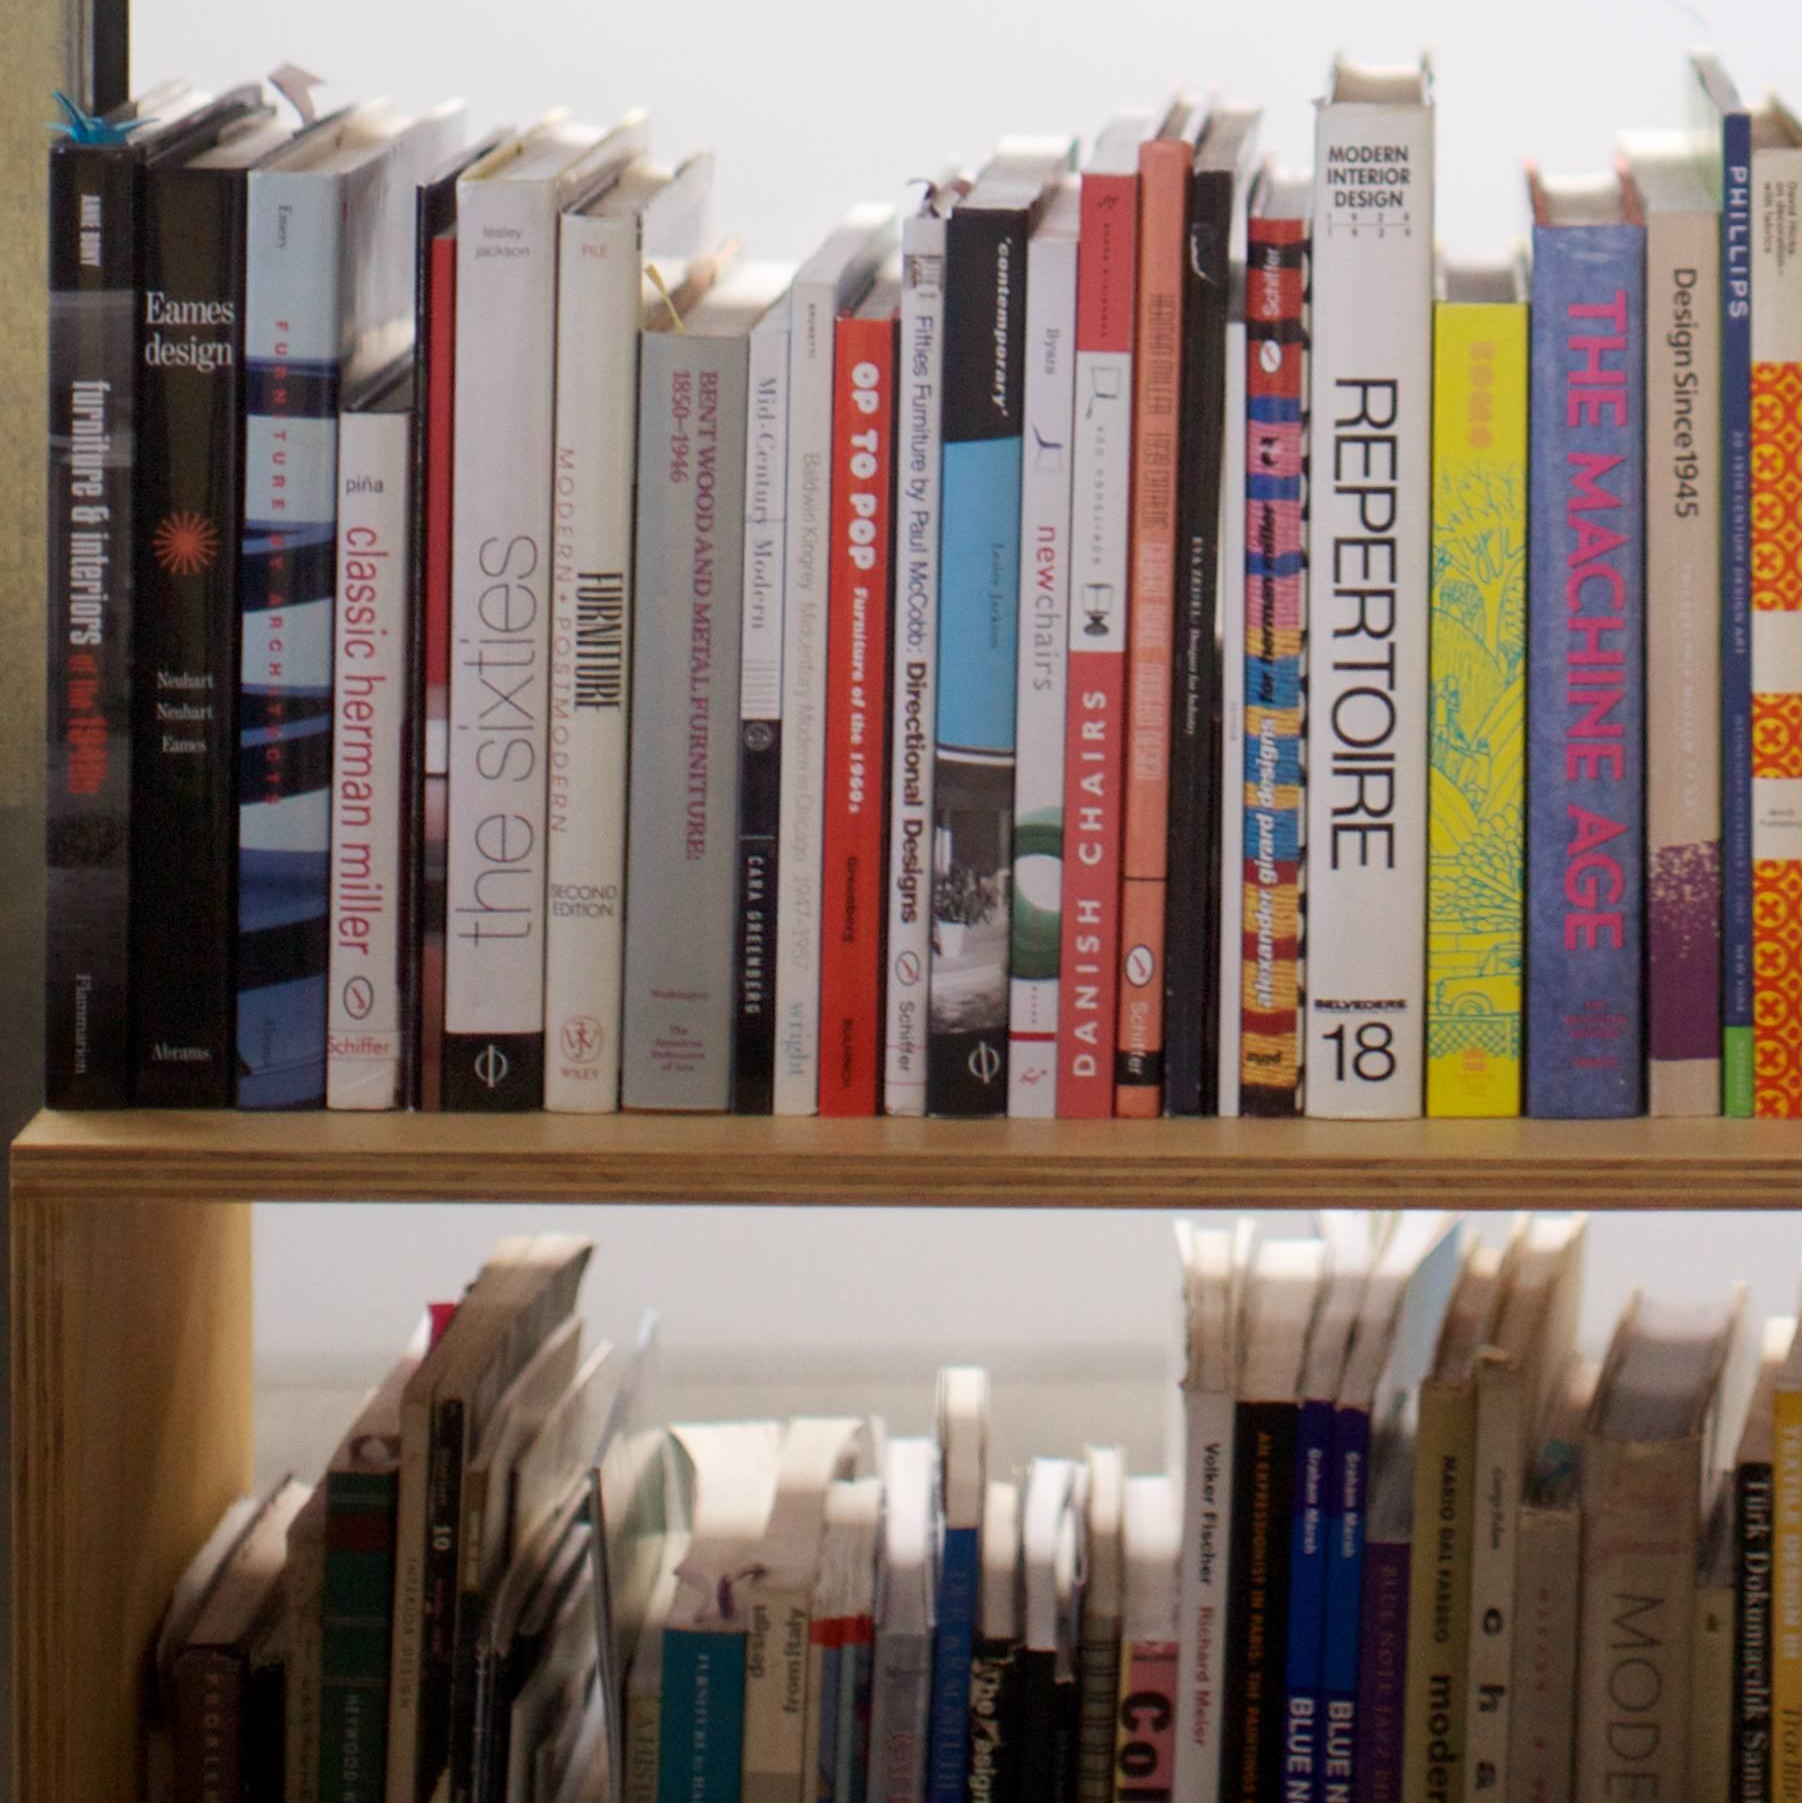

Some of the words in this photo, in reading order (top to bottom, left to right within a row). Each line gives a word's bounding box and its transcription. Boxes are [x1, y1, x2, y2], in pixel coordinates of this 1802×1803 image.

[1326, 168, 1411, 185] INTERIOR
[1328, 146, 1409, 162] MODERN
[275, 205, 292, 250] Emery
[1335, 190, 1404, 208] DESIGN
[1728, 165, 1748, 320] PHILLIPS
[144, 291, 236, 325] Eames
[1261, 246, 1282, 319] Schiffer
[1667, 267, 1698, 367] Design
[144, 333, 233, 374] design
[912, 315, 933, 377] Fifties
[1567, 289, 1627, 427] THE
[698, 371, 718, 440] BENT
[851, 360, 880, 414] OP
[71, 380, 110, 496] furniture
[750, 377, 777, 526] Mid-Century
[849, 429, 879, 479] TO
[910, 383, 933, 472] Furniture
[71, 505, 110, 525] &
[345, 478, 384, 494] piña
[556, 447, 576, 582] MODERN
[694, 446, 716, 533] WOOD
[906, 477, 931, 502] by
[691, 539, 714, 598] AND
[848, 493, 878, 570] POP
[909, 510, 929, 553] Paul
[70, 532, 110, 646] interiors
[344, 527, 388, 660] classic
[750, 538, 776, 630] Modern
[905, 561, 928, 653] McCobb:
[1565, 451, 1628, 781] MACHINE
[456, 534, 539, 783] sixties
[573, 571, 624, 713] FURNITURE
[690, 601, 711, 691] METAL
[851, 587, 868, 682] Furniture
[1331, 377, 1398, 871] REPERTOIRE
[67, 654, 98, 676] of
[68, 679, 98, 710] the
[850, 687, 867, 709] of
[342, 674, 386, 828] herman
[550, 616, 570, 834] POSTMODERN
[850, 713, 866, 745] the
[903, 661, 926, 806] Directional
[1255, 717, 1274, 808] designs
[686, 696, 709, 861] FURNITURE:
[847, 752, 864, 814] 1960s
[1079, 690, 1108, 865] CHAIRS
[455, 813, 533, 949] the
[746, 855, 765, 904] CARA
[898, 819, 924, 924] Designs
[1255, 813, 1274, 884] girard
[1563, 803, 1629, 951] AGE
[338, 843, 383, 957] miller
[550, 883, 618, 901] SECOND
[552, 902, 615, 918] EDITION
[841, 856, 858, 943] Greenberg
[743, 910, 763, 1015] GREENBERG
[1254, 887, 1274, 1009] alexander
[74, 974, 93, 1074] Flammarion
[1073, 899, 1103, 1079] DANISH
[329, 1035, 393, 1056] Schiffer
[783, 1001, 811, 1078] wright
[898, 1001, 915, 1073] Schiffer
[1126, 1001, 1150, 1076] Schiffer
[1321, 1021, 1397, 1082] 18
[1202, 1442, 1222, 1505] Volker
[1198, 1511, 1220, 1586] Fischer
[1194, 1606, 1214, 1683] Richard
[1193, 1688, 1212, 1747] Meier
[1288, 1697, 1314, 1773] BLUE
[1325, 1700, 1353, 1777] BLUE
